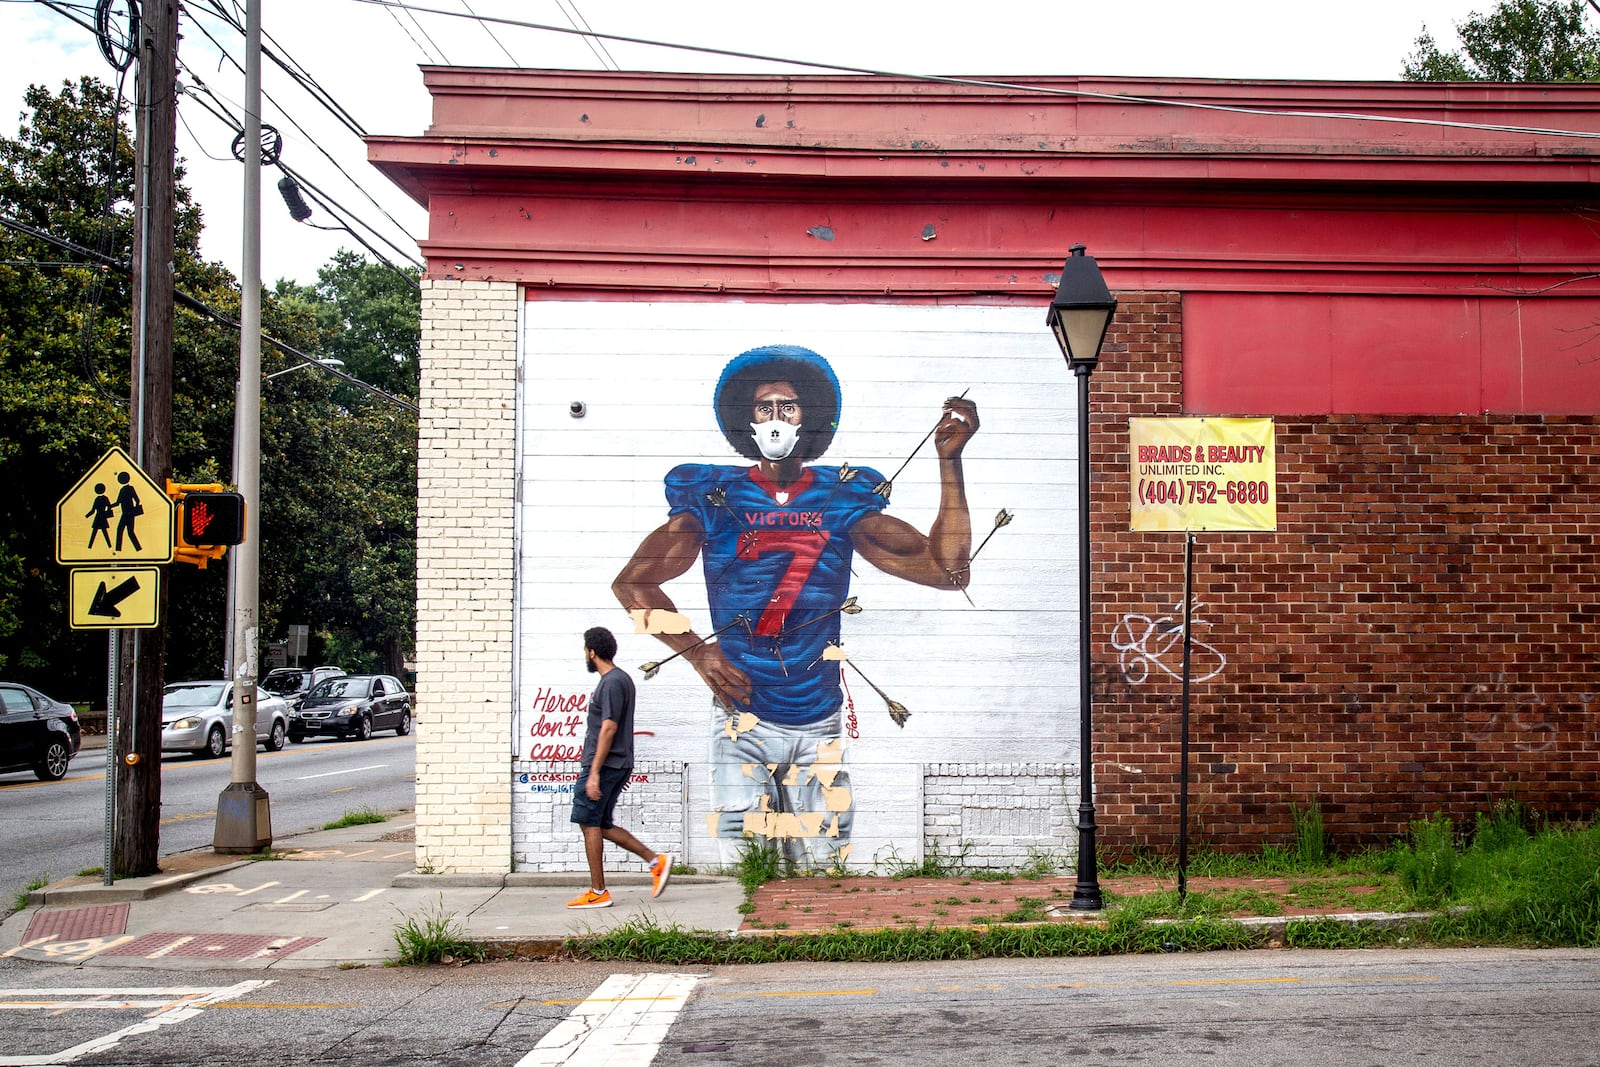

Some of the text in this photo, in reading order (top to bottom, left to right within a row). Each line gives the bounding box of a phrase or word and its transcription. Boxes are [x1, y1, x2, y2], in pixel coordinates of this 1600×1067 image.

[1138, 445, 1265, 463] BRAIDS & BEAUTY
[1139, 465, 1225, 476] UNLIMITED INC.
[736, 530, 830, 636] 7
[533, 687, 593, 712] Heroe
[530, 714, 583, 737] don't
